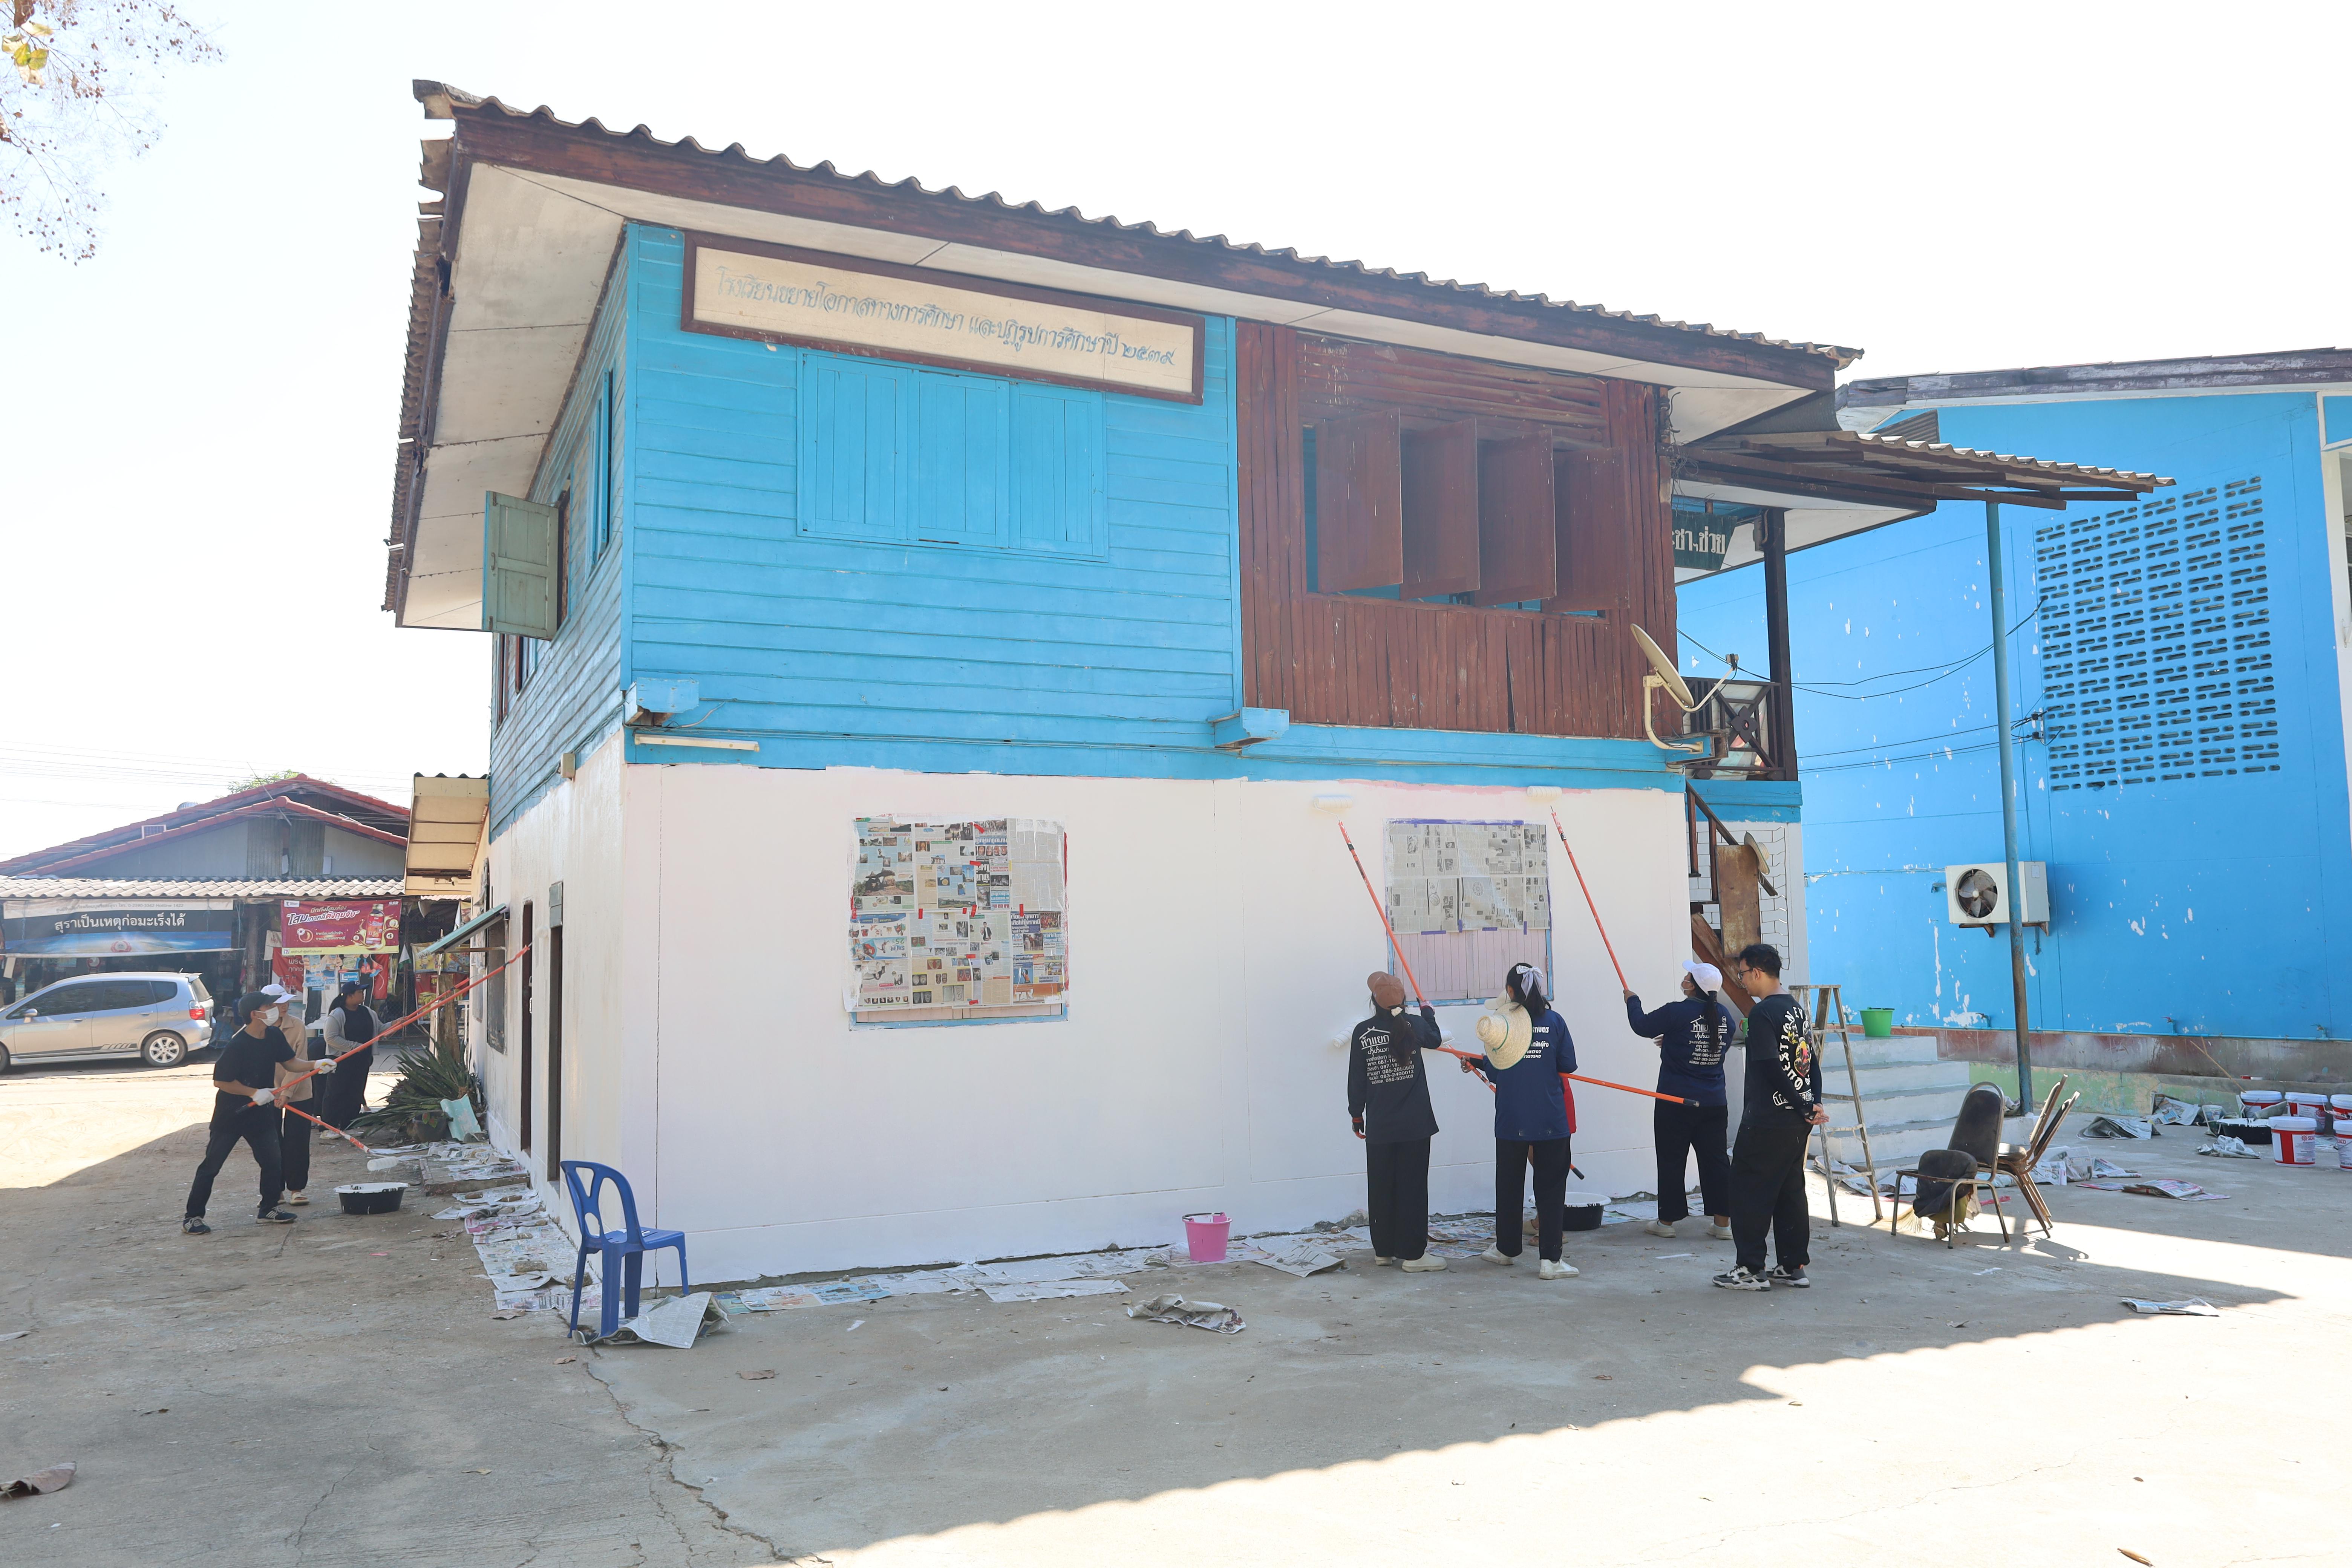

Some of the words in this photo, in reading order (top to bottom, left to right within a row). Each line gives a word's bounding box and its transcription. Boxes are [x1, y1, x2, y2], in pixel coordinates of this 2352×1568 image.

[716, 266, 965, 331] โรงเรียนขยายโอกาสทางการศึกษา
[1121, 342, 1177, 366] ๒๕๓๙
[55, 912, 186, 933] สุราเป็นเหตุก่อมะเร็งได้
[1015, 989, 1034, 1001] TAX
[1693, 1021, 1710, 1032] ห้าแย
[1361, 1034, 1390, 1047] ห้าแยก
[1380, 1070, 1414, 1079] 083-2400012
[1386, 1074, 1414, 1083] 055-532409
